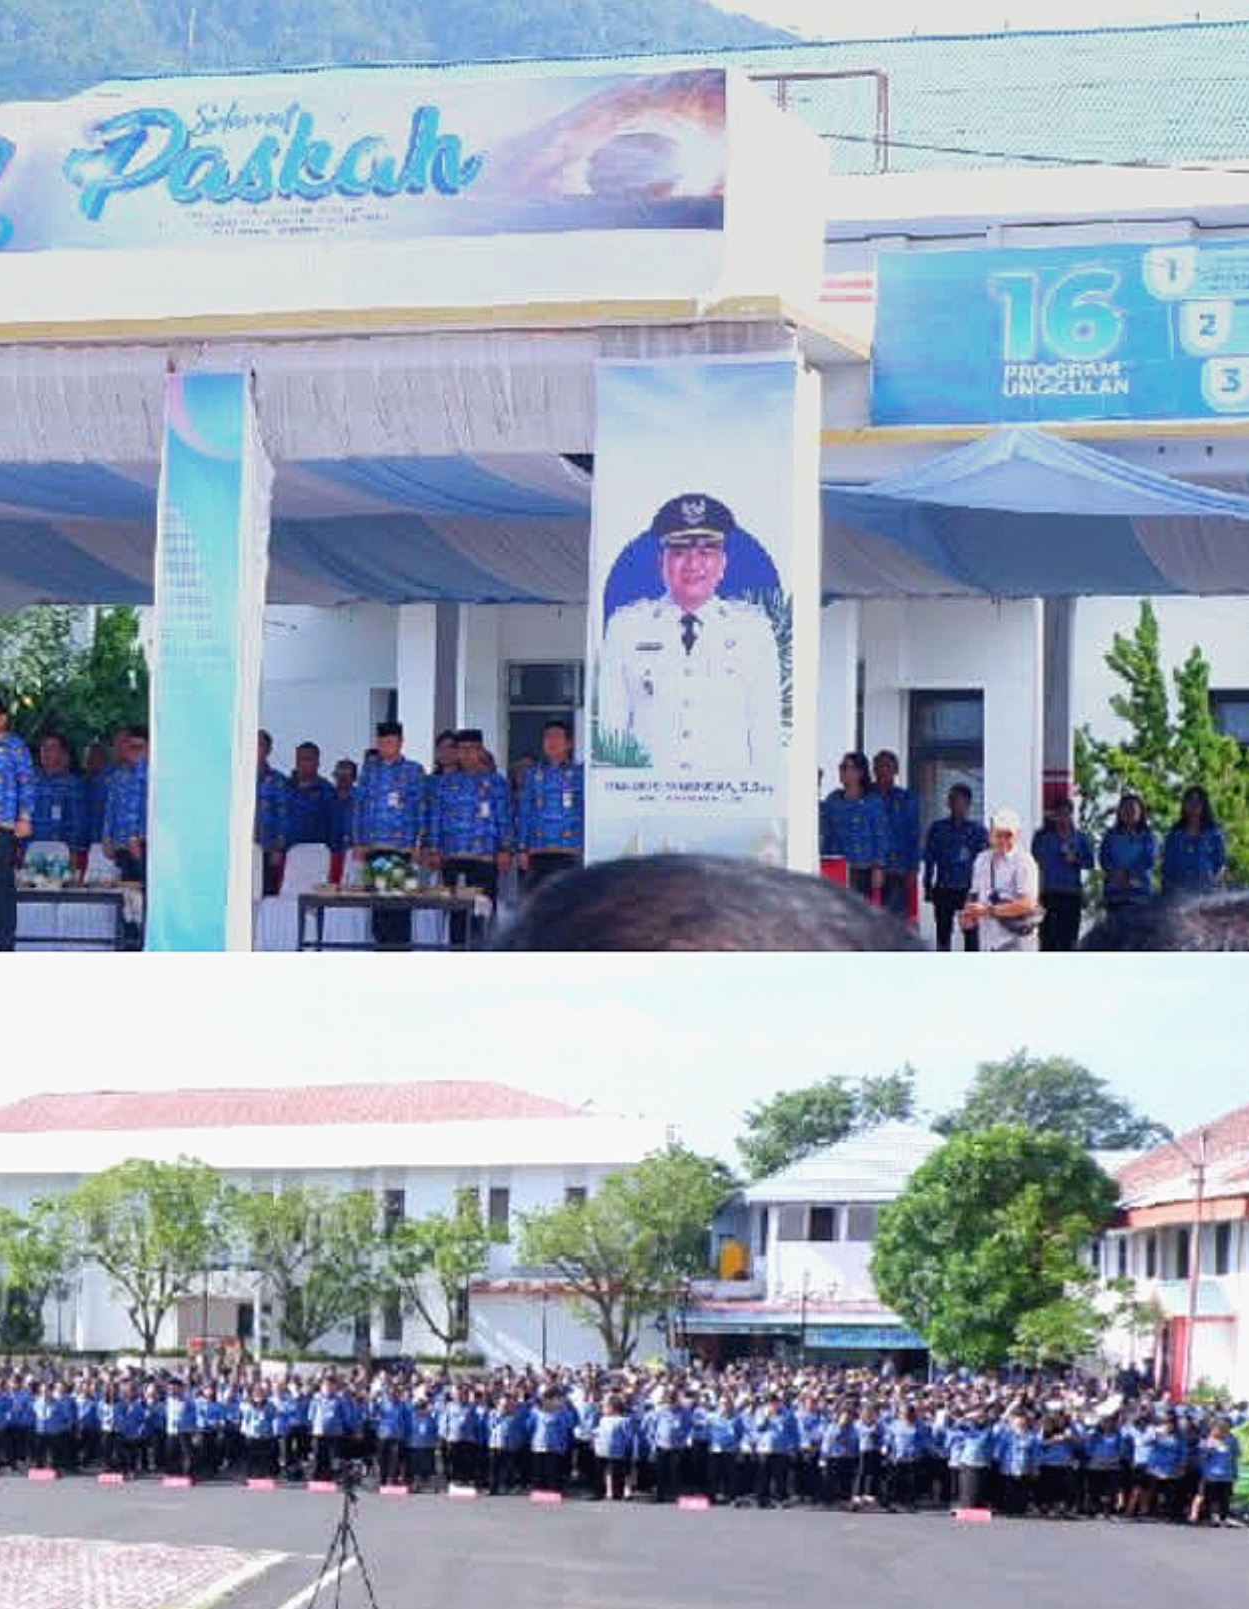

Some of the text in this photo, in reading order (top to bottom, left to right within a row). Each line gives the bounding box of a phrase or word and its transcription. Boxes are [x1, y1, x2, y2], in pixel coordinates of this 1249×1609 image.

[62, 104, 485, 221] Paskah
[988, 265, 1125, 362] 16
[1199, 313, 1218, 337] 2
[1004, 363, 1122, 378] PROGRAM
[1221, 368, 1242, 393] 3
[1003, 378, 1130, 396] UNGGULAN
